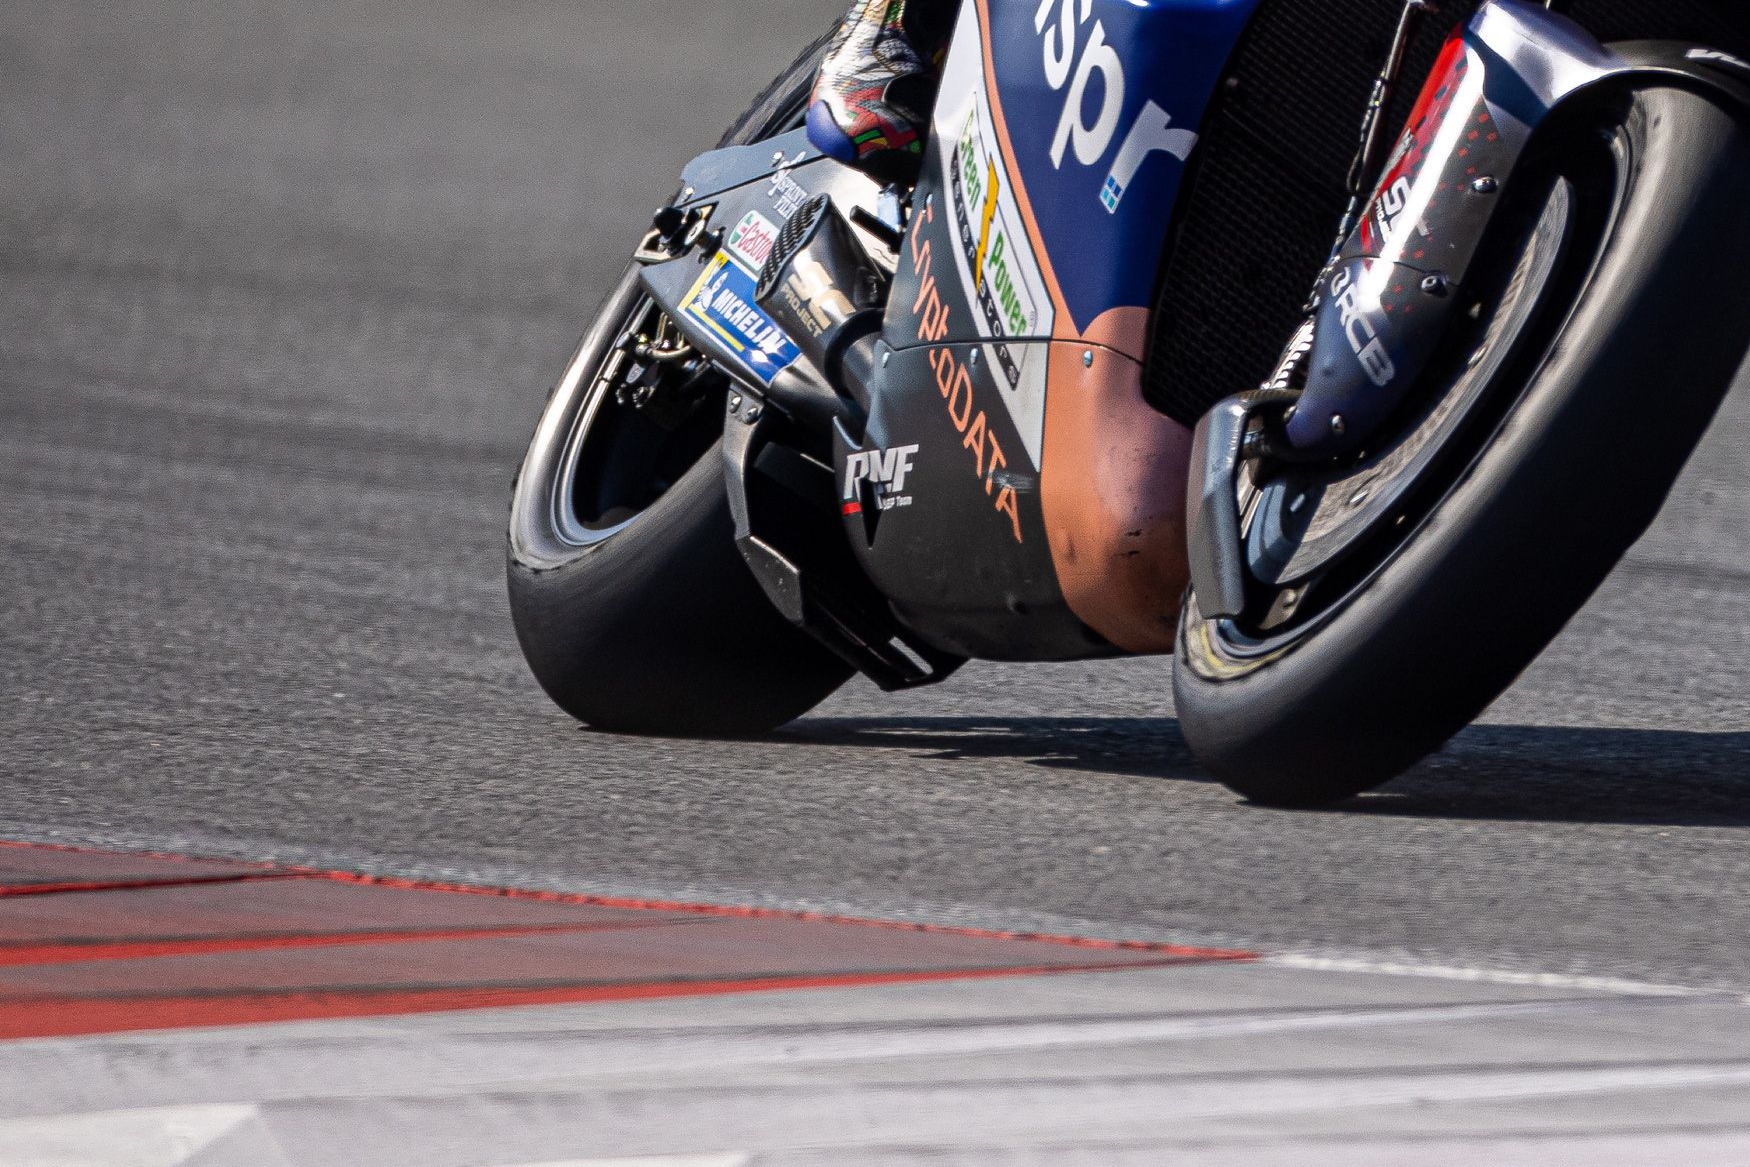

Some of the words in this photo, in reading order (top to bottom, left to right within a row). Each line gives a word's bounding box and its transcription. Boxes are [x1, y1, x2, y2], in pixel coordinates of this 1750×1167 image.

[781, 282, 823, 338] PROJECT
[988, 229, 1027, 338] Power
[711, 288, 788, 353] MICHELIN
